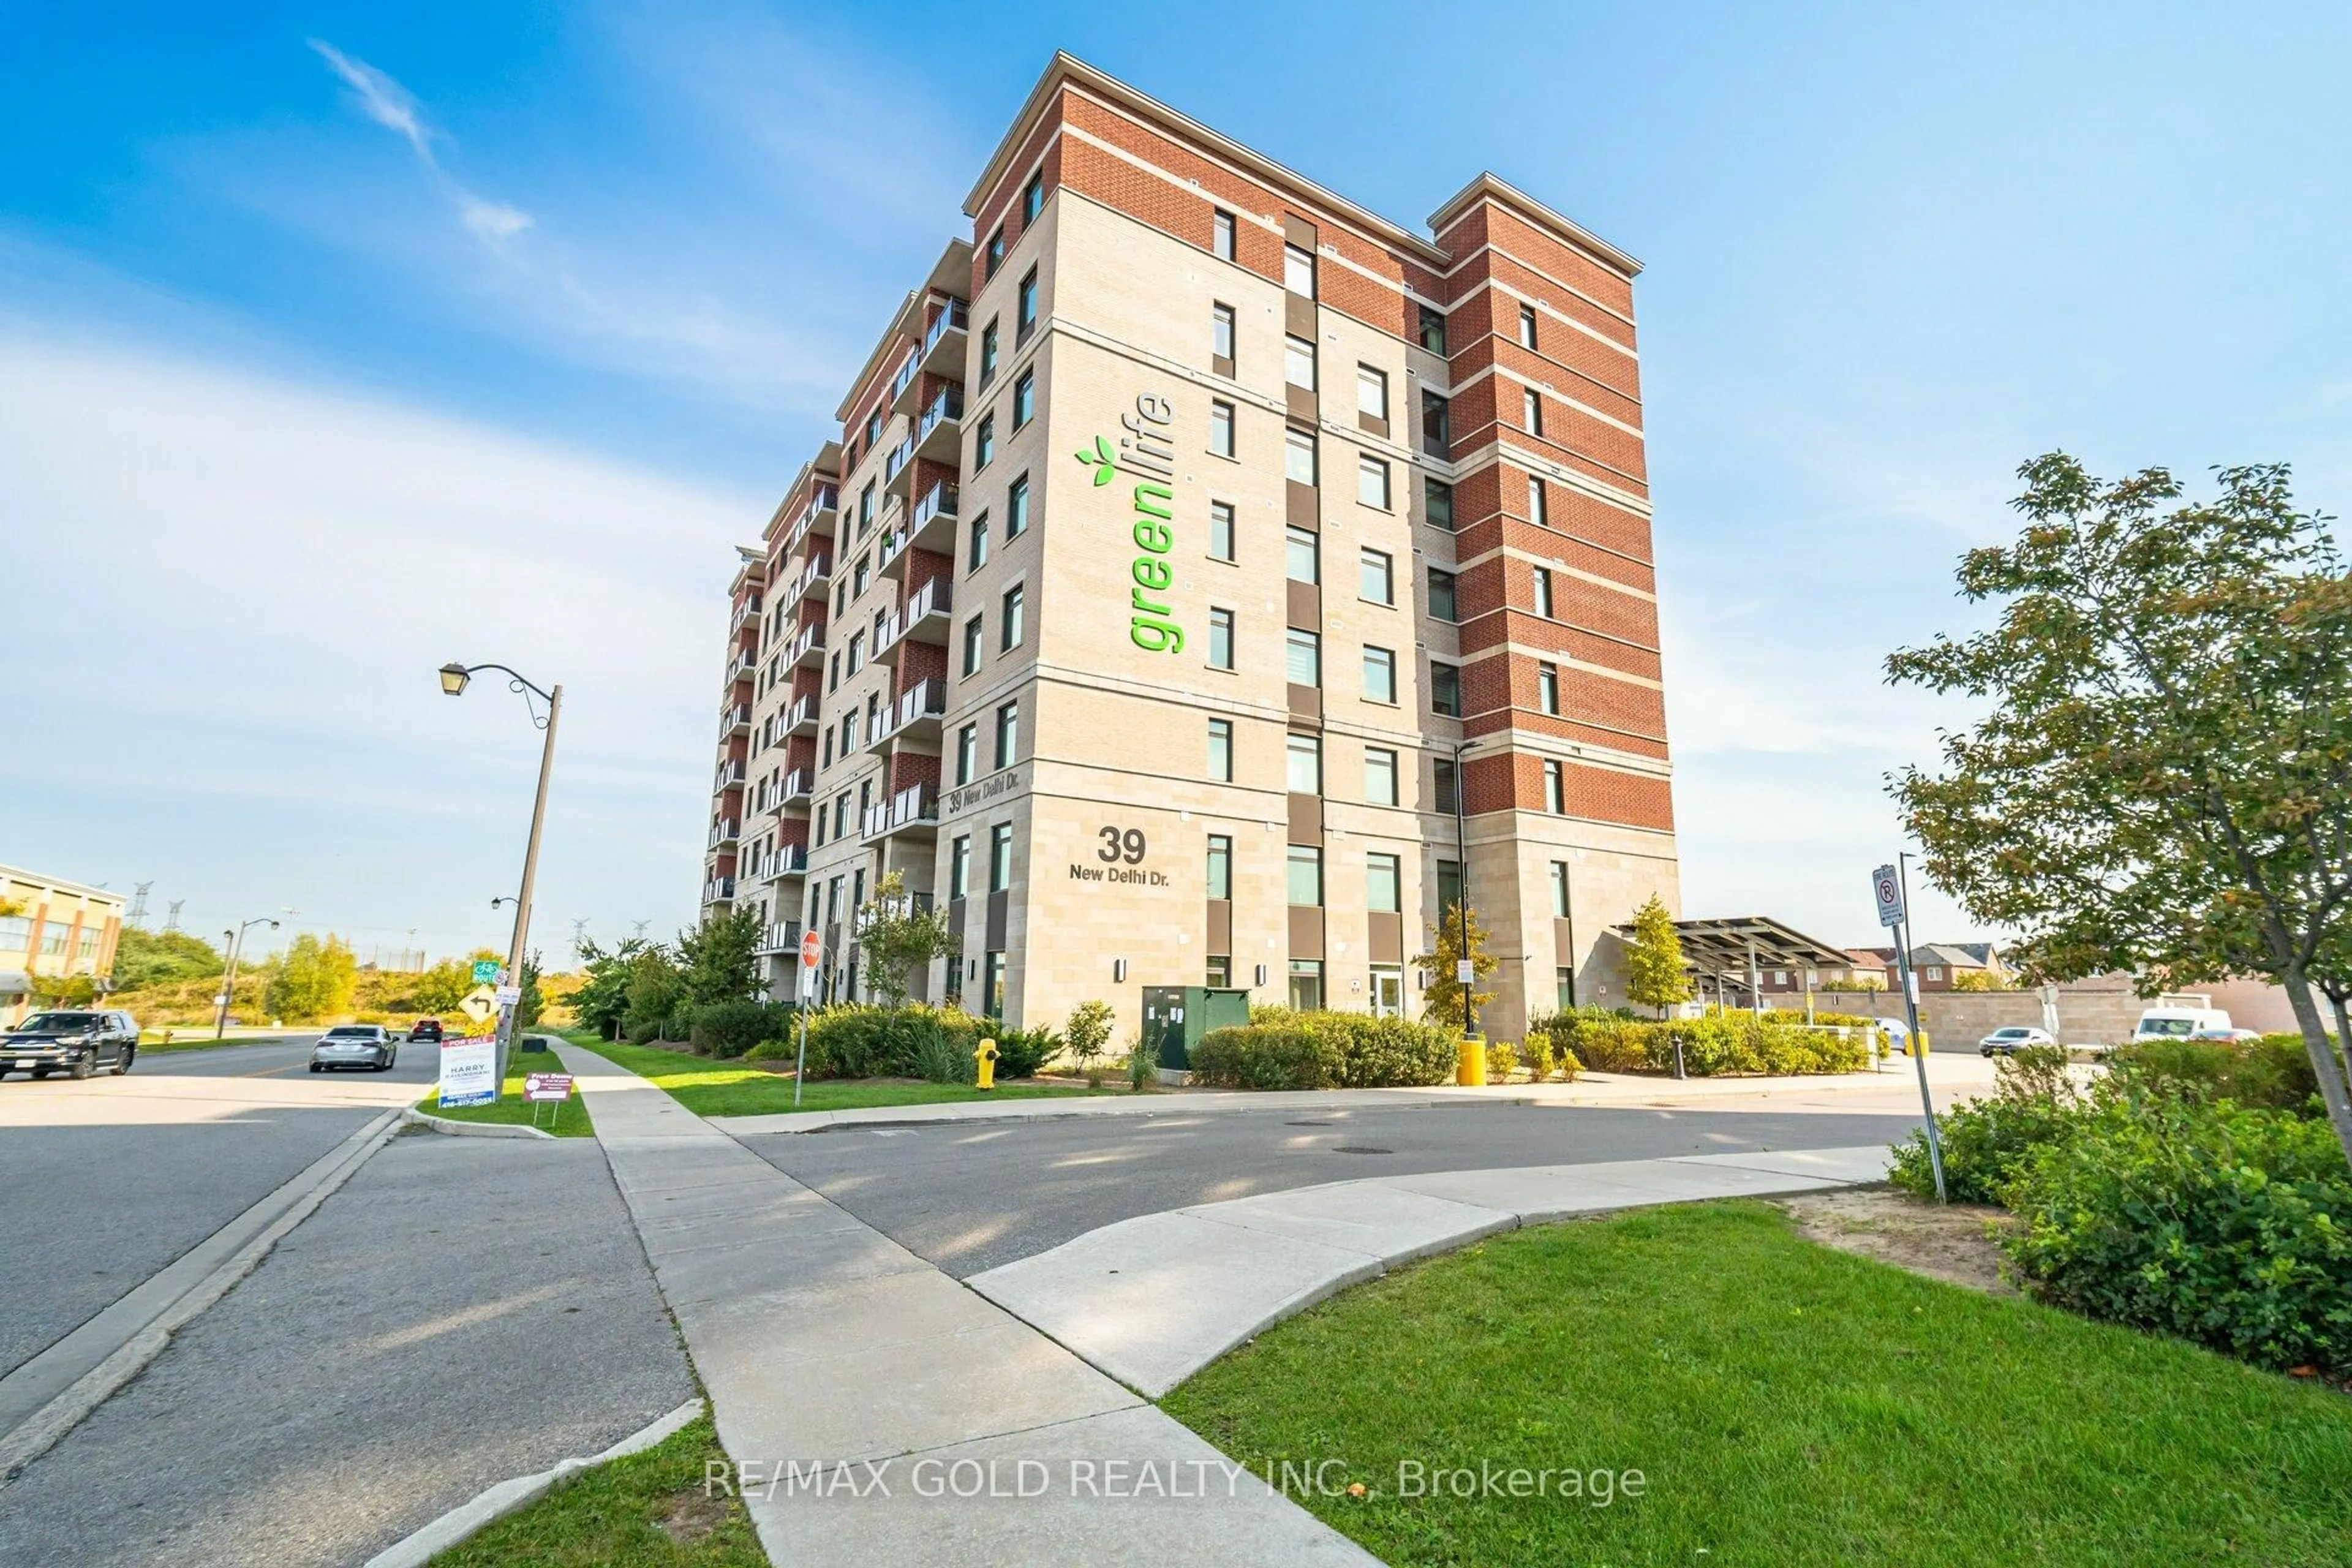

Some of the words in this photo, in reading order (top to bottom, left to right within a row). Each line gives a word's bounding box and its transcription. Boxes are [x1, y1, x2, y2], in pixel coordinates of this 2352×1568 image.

[949, 792, 962, 813] 39
[964, 788, 981, 807] New
[982, 775, 1005, 799] Delhi
[1098, 826, 1147, 865] 39
[1069, 864, 1104, 882] New
[1108, 867, 1147, 885] Delhi
[1150, 870, 1169, 887] Dr.
[802, 942, 820, 957] STOP
[470, 1027, 486, 1038] 20
[467, 1036, 488, 1045] SALE
[450, 1064, 485, 1073] HARRY
